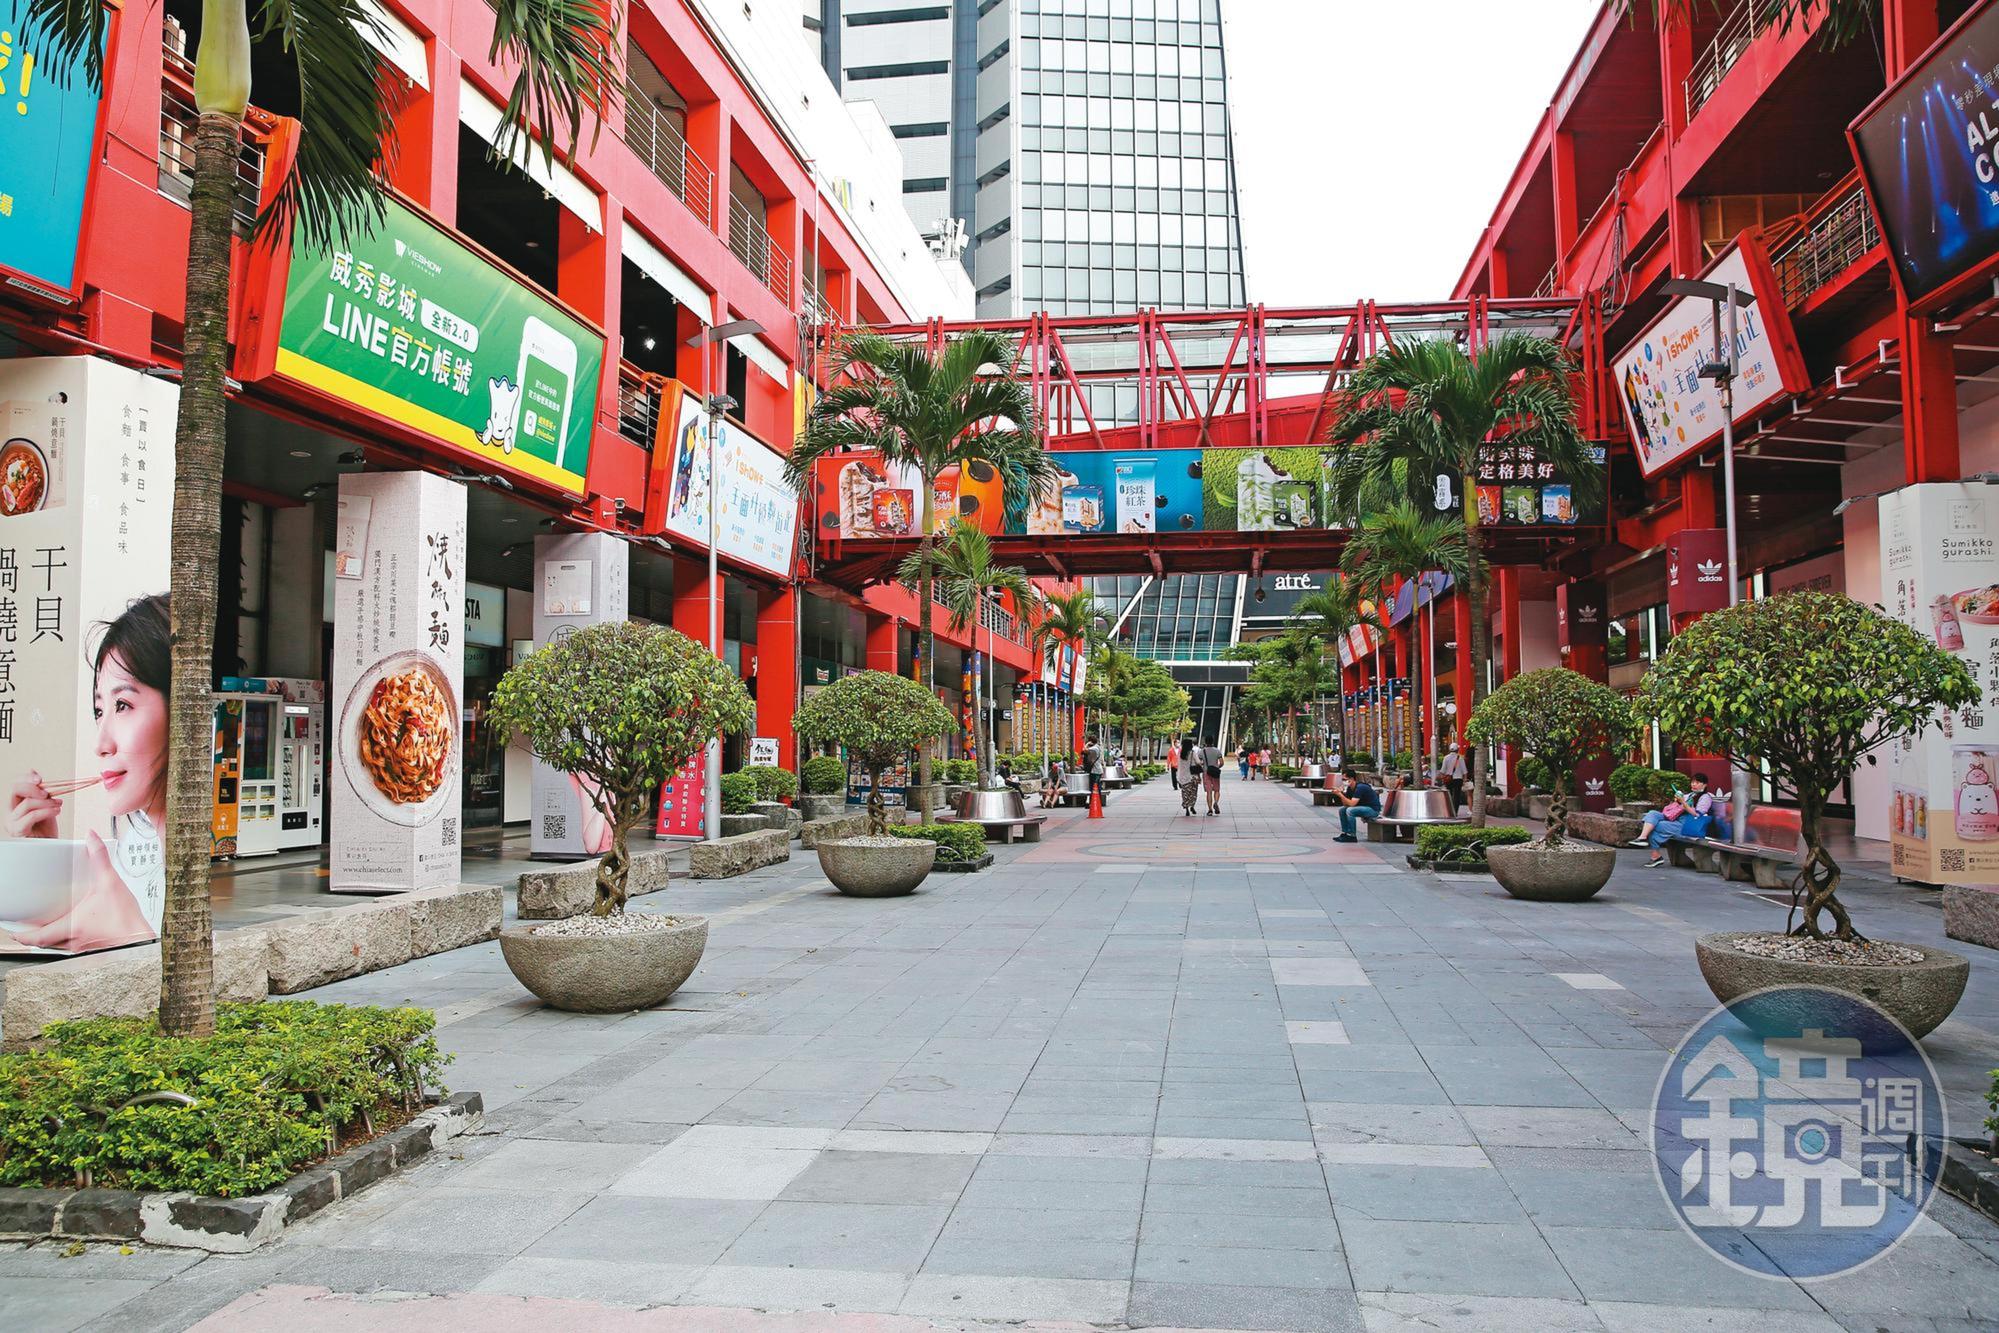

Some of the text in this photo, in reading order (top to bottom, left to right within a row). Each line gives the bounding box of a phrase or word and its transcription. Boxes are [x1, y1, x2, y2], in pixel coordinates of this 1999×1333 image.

[330, 251, 417, 323] 威秀影城
[431, 310, 470, 344] 全新2.0
[322, 292, 473, 396] LINE官方帳號
[1478, 463, 1554, 480] 定格美好
[1125, 485, 1146, 496] 珍珠
[1125, 496, 1146, 507] 紅茶
[1942, 538, 1993, 548] Sumikko
[1942, 548, 1991, 559] gurashi
[1275, 573, 1311, 590] atré
[30, 545, 68, 644] 干貝
[427, 532, 453, 653] 燒椒麵
